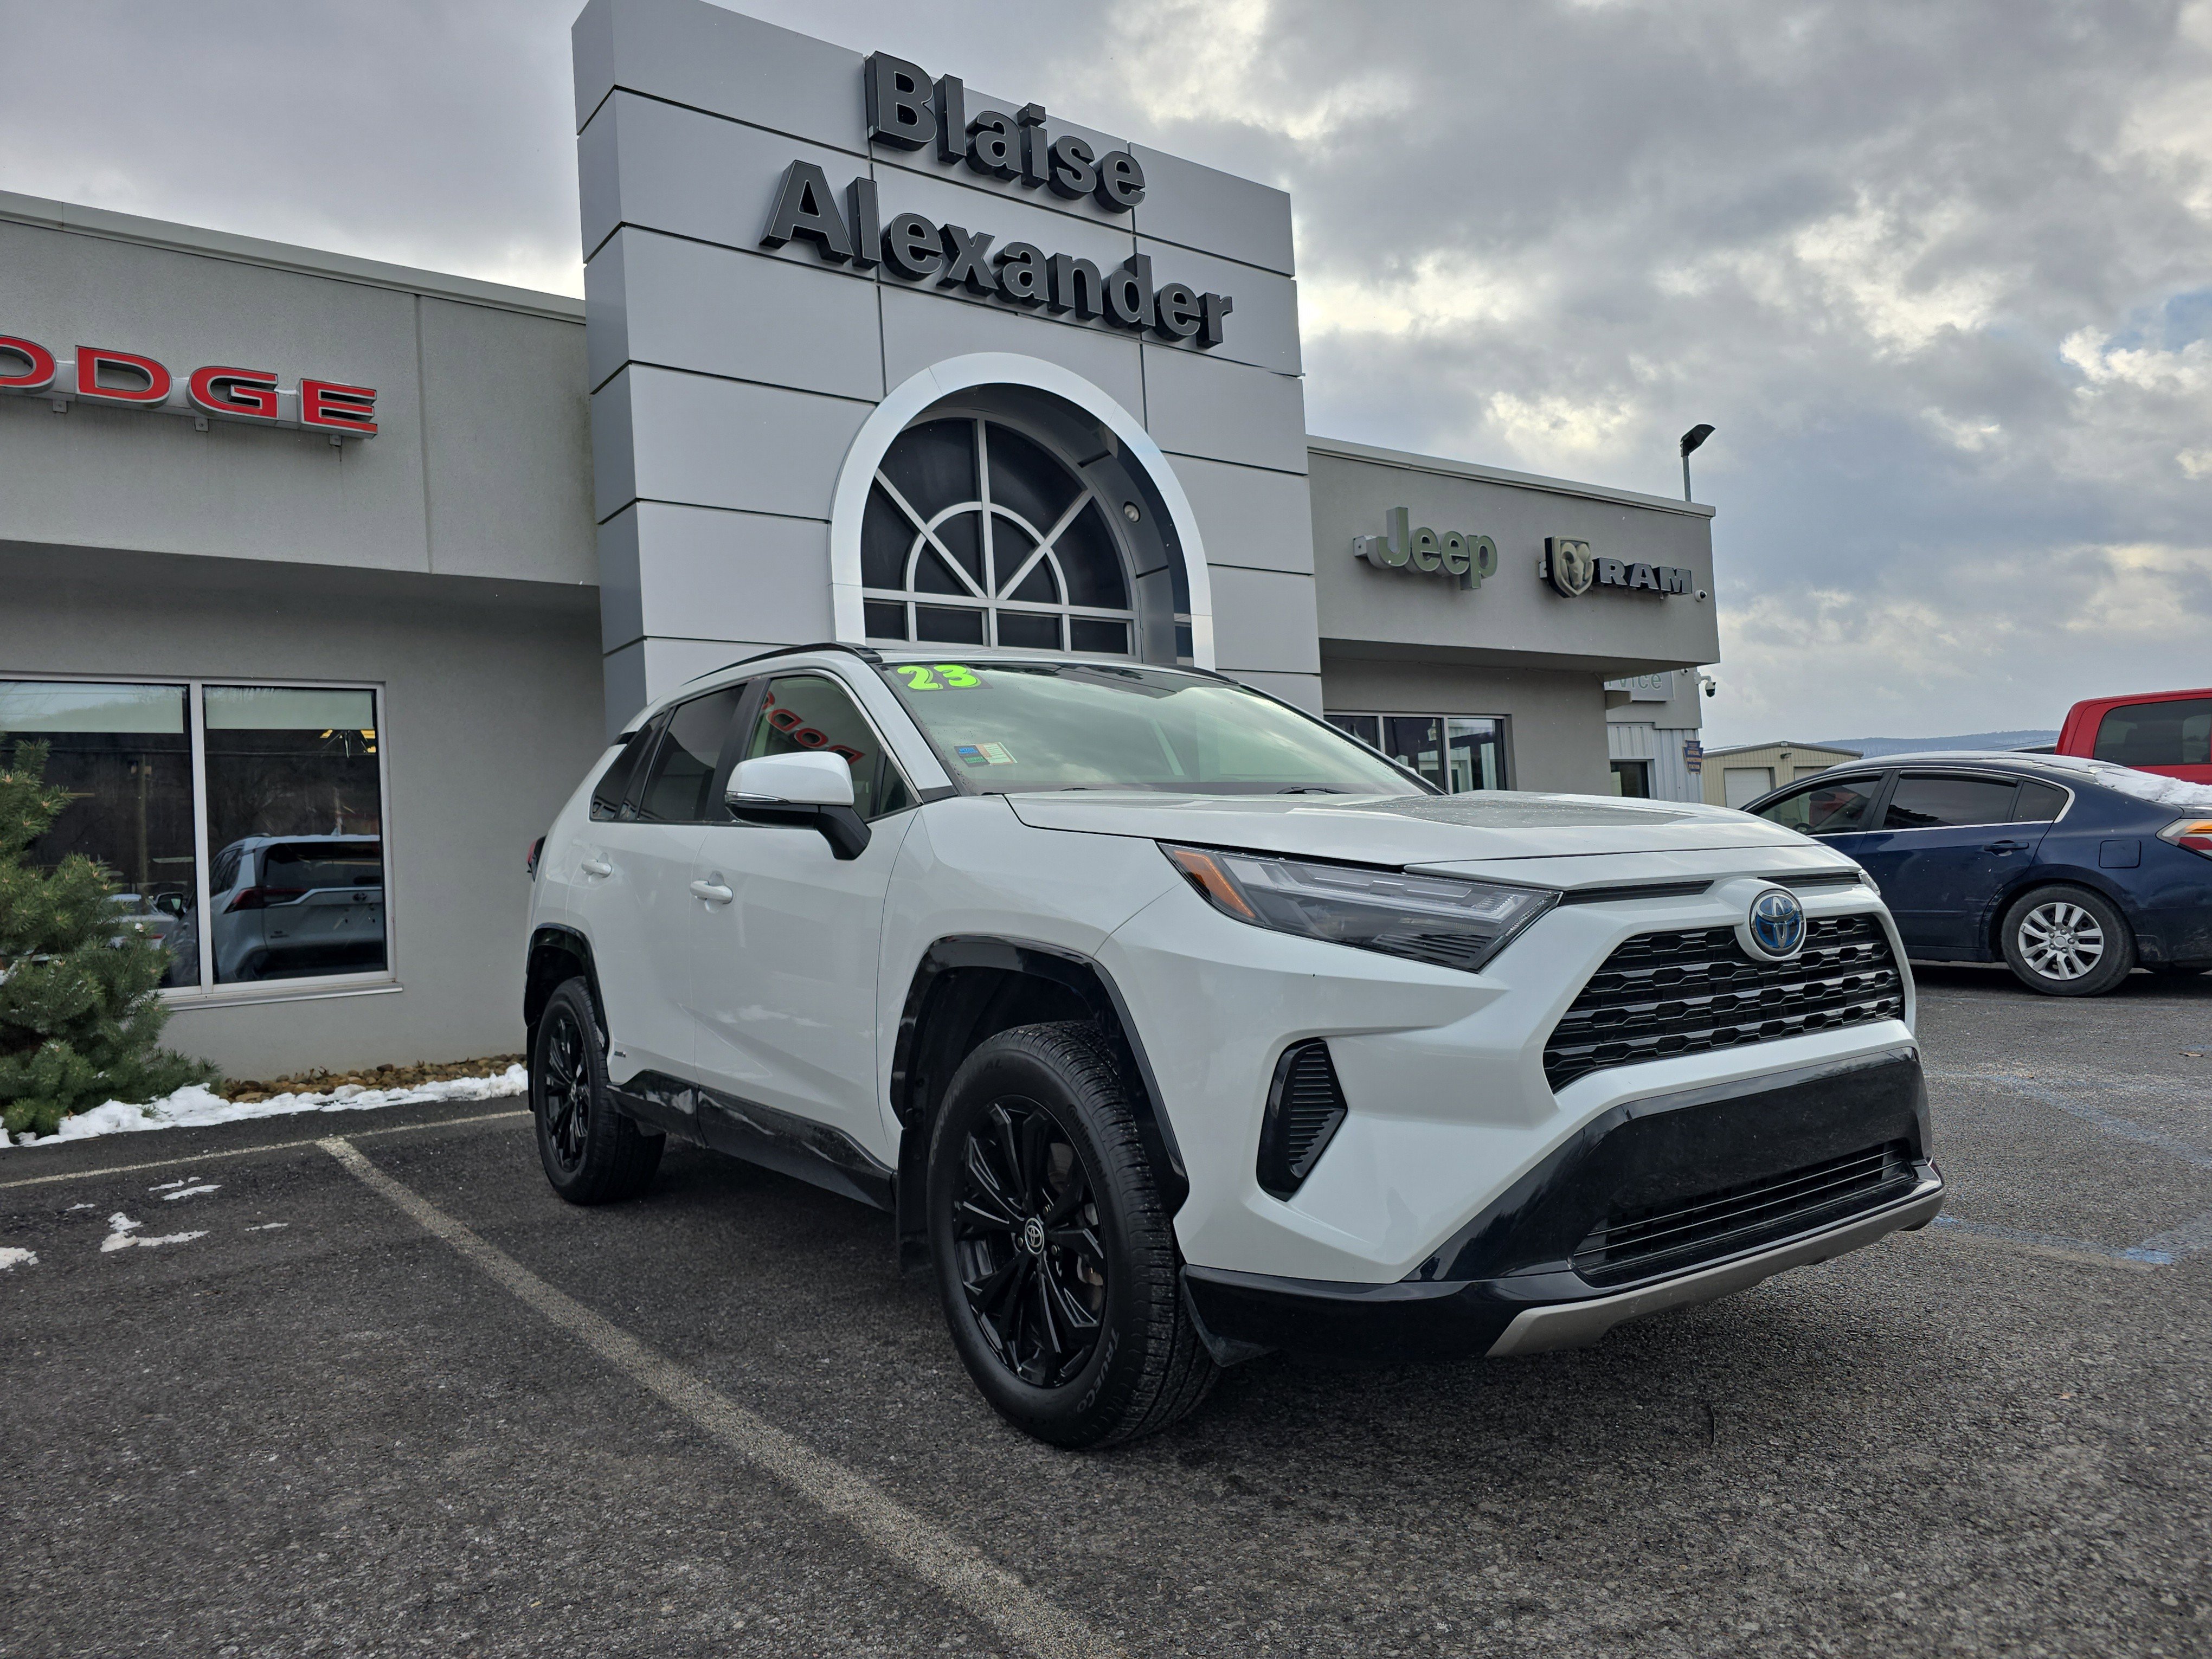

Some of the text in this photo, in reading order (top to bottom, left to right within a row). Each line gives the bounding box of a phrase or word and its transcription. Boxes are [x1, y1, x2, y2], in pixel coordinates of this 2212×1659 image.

[865, 50, 1146, 214] Blaise
[759, 159, 1232, 349] Alexander
[1367, 506, 1498, 590] Jeep
[1593, 557, 1692, 595] RAM
[897, 664, 981, 691] 23
[1066, 1103, 1107, 1181] Continental
